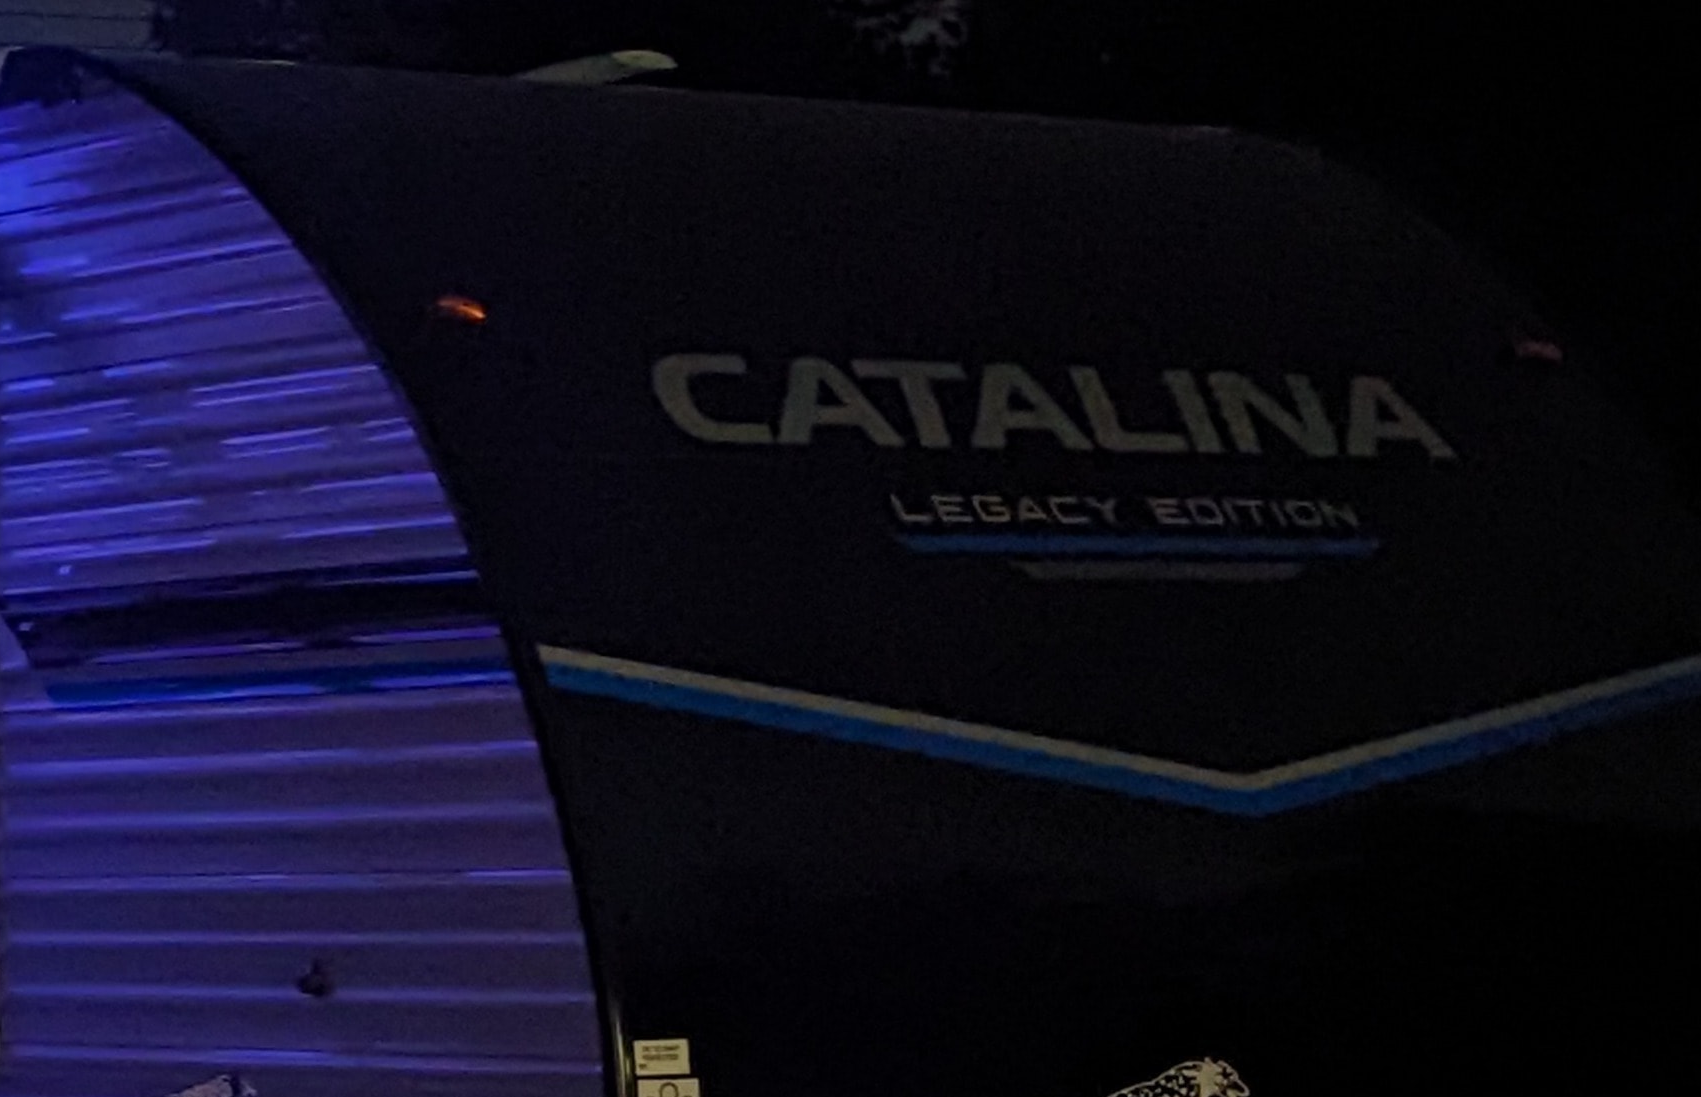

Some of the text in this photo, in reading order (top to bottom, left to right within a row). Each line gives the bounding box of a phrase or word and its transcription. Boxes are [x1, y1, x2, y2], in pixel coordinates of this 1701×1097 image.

[651, 353, 1459, 461] CATALINA
[891, 493, 1361, 529] LEGACY EDITION
